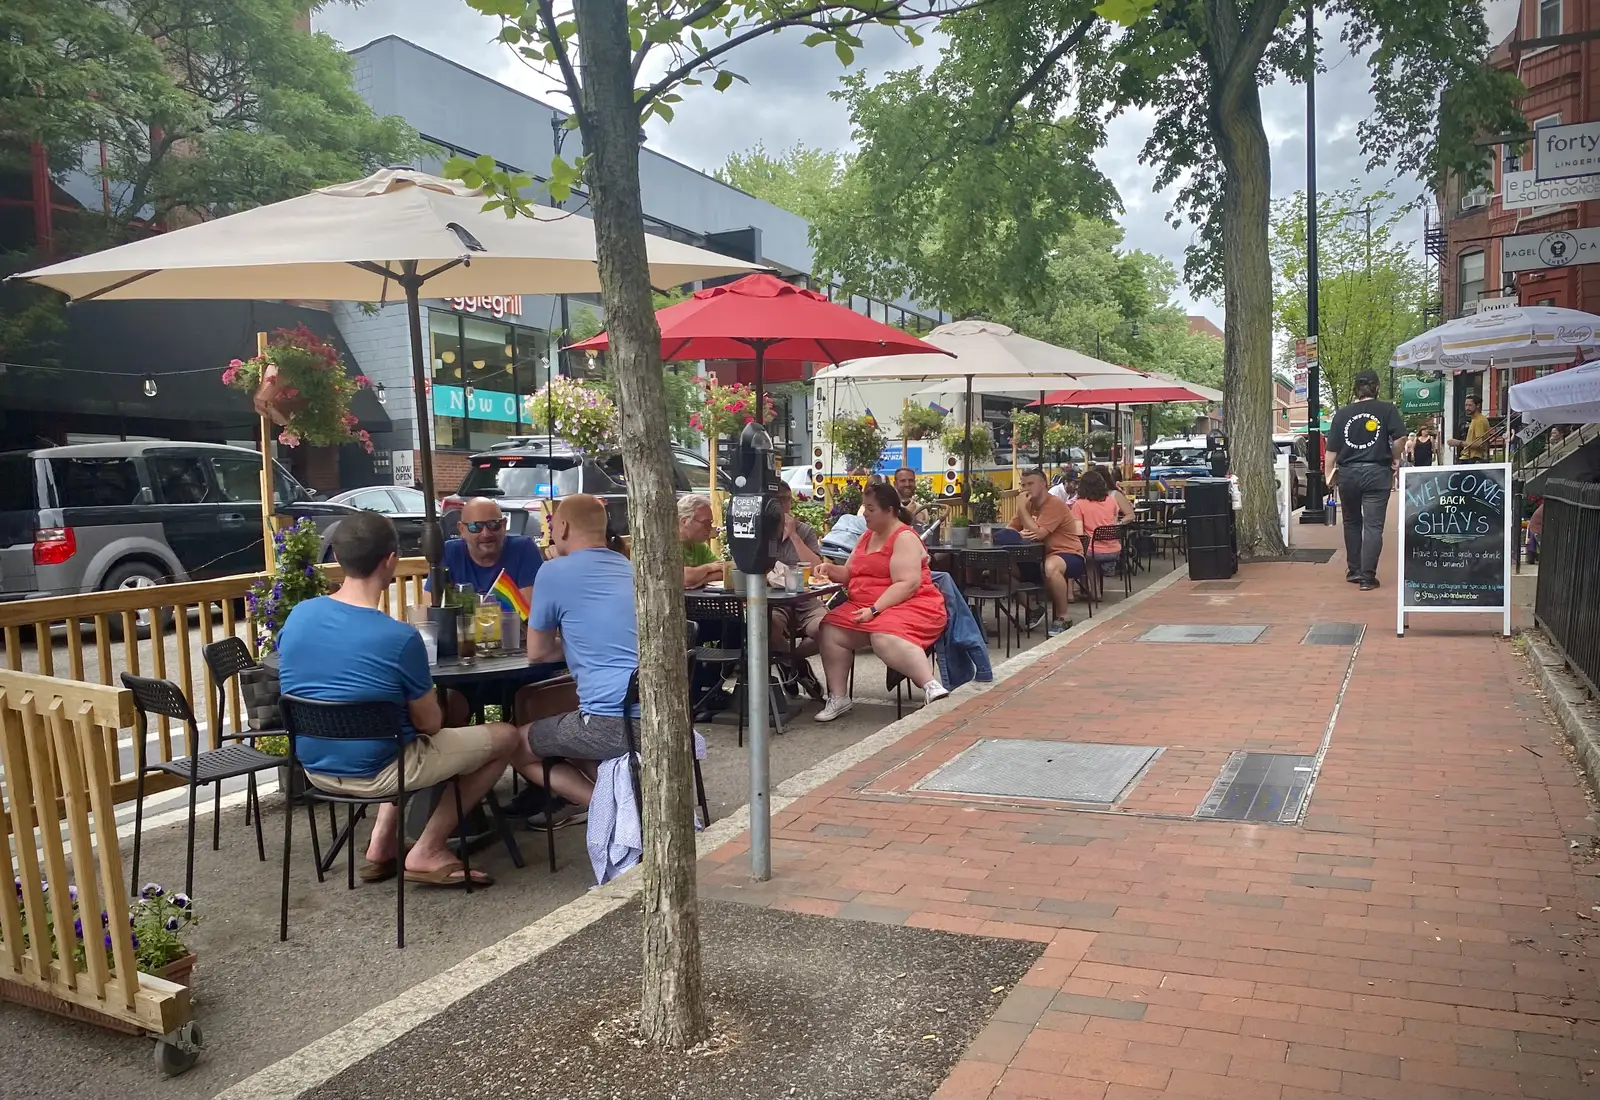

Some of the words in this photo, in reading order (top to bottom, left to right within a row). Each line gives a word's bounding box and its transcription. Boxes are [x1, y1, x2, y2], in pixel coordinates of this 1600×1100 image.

[1546, 134, 1600, 152] forty
[1519, 186, 1559, 202] salon
[1546, 233, 1571, 243] BLACK
[1505, 249, 1537, 258] BAGEL
[1547, 256, 1569, 265] SHEEP
[444, 295, 522, 318] ggiegrill
[450, 391, 492, 413] Now
[1405, 472, 1504, 507] WELCOME
[1440, 496, 1466, 505] BACK
[735, 510, 752, 518] CARE
[1444, 505, 1457, 513] TO
[1414, 511, 1490, 535] SHAY'S
[1412, 547, 1430, 559] Have
[1457, 550, 1473, 560] grab
[1482, 551, 1501, 559] drink
